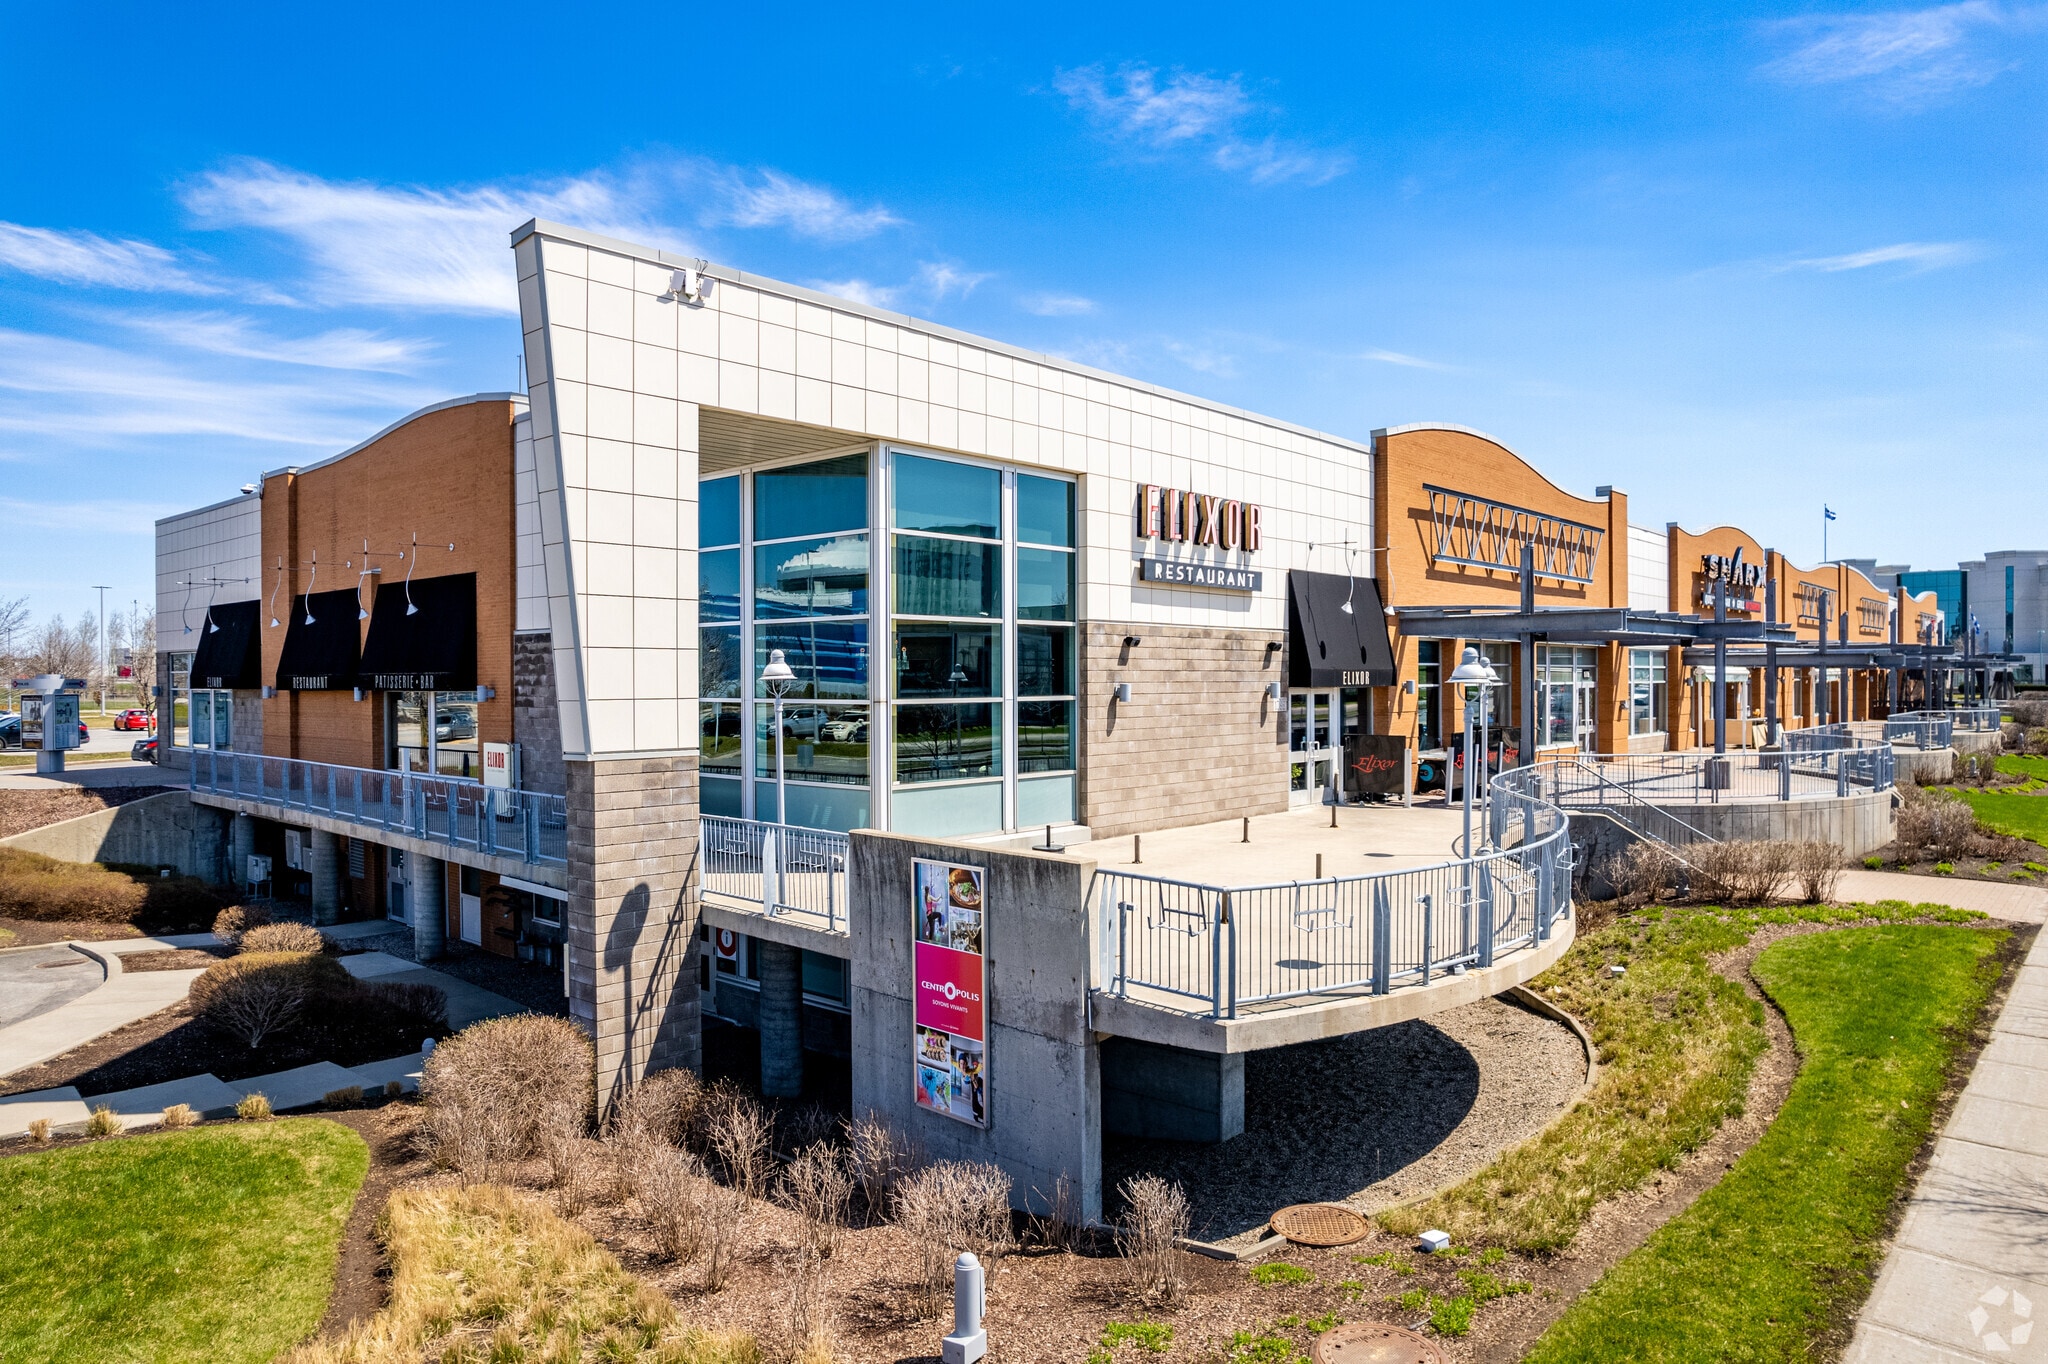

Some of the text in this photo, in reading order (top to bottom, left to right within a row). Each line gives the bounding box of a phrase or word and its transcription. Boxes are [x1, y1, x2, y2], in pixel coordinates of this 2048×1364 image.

[1138, 484, 1263, 552] ELIXOR
[1154, 562, 1256, 589] RESTAURANT
[293, 676, 328, 689] RESTAURANT
[375, 675, 434, 689] PATISSERIE BAR
[1342, 671, 1370, 686] ELIXOR
[487, 751, 505, 769] ELIXOR
[1351, 754, 1399, 773] Elixor
[921, 980, 980, 1002] CENTROPOLIS
[932, 999, 968, 1014] SOYONS VIVANTS
